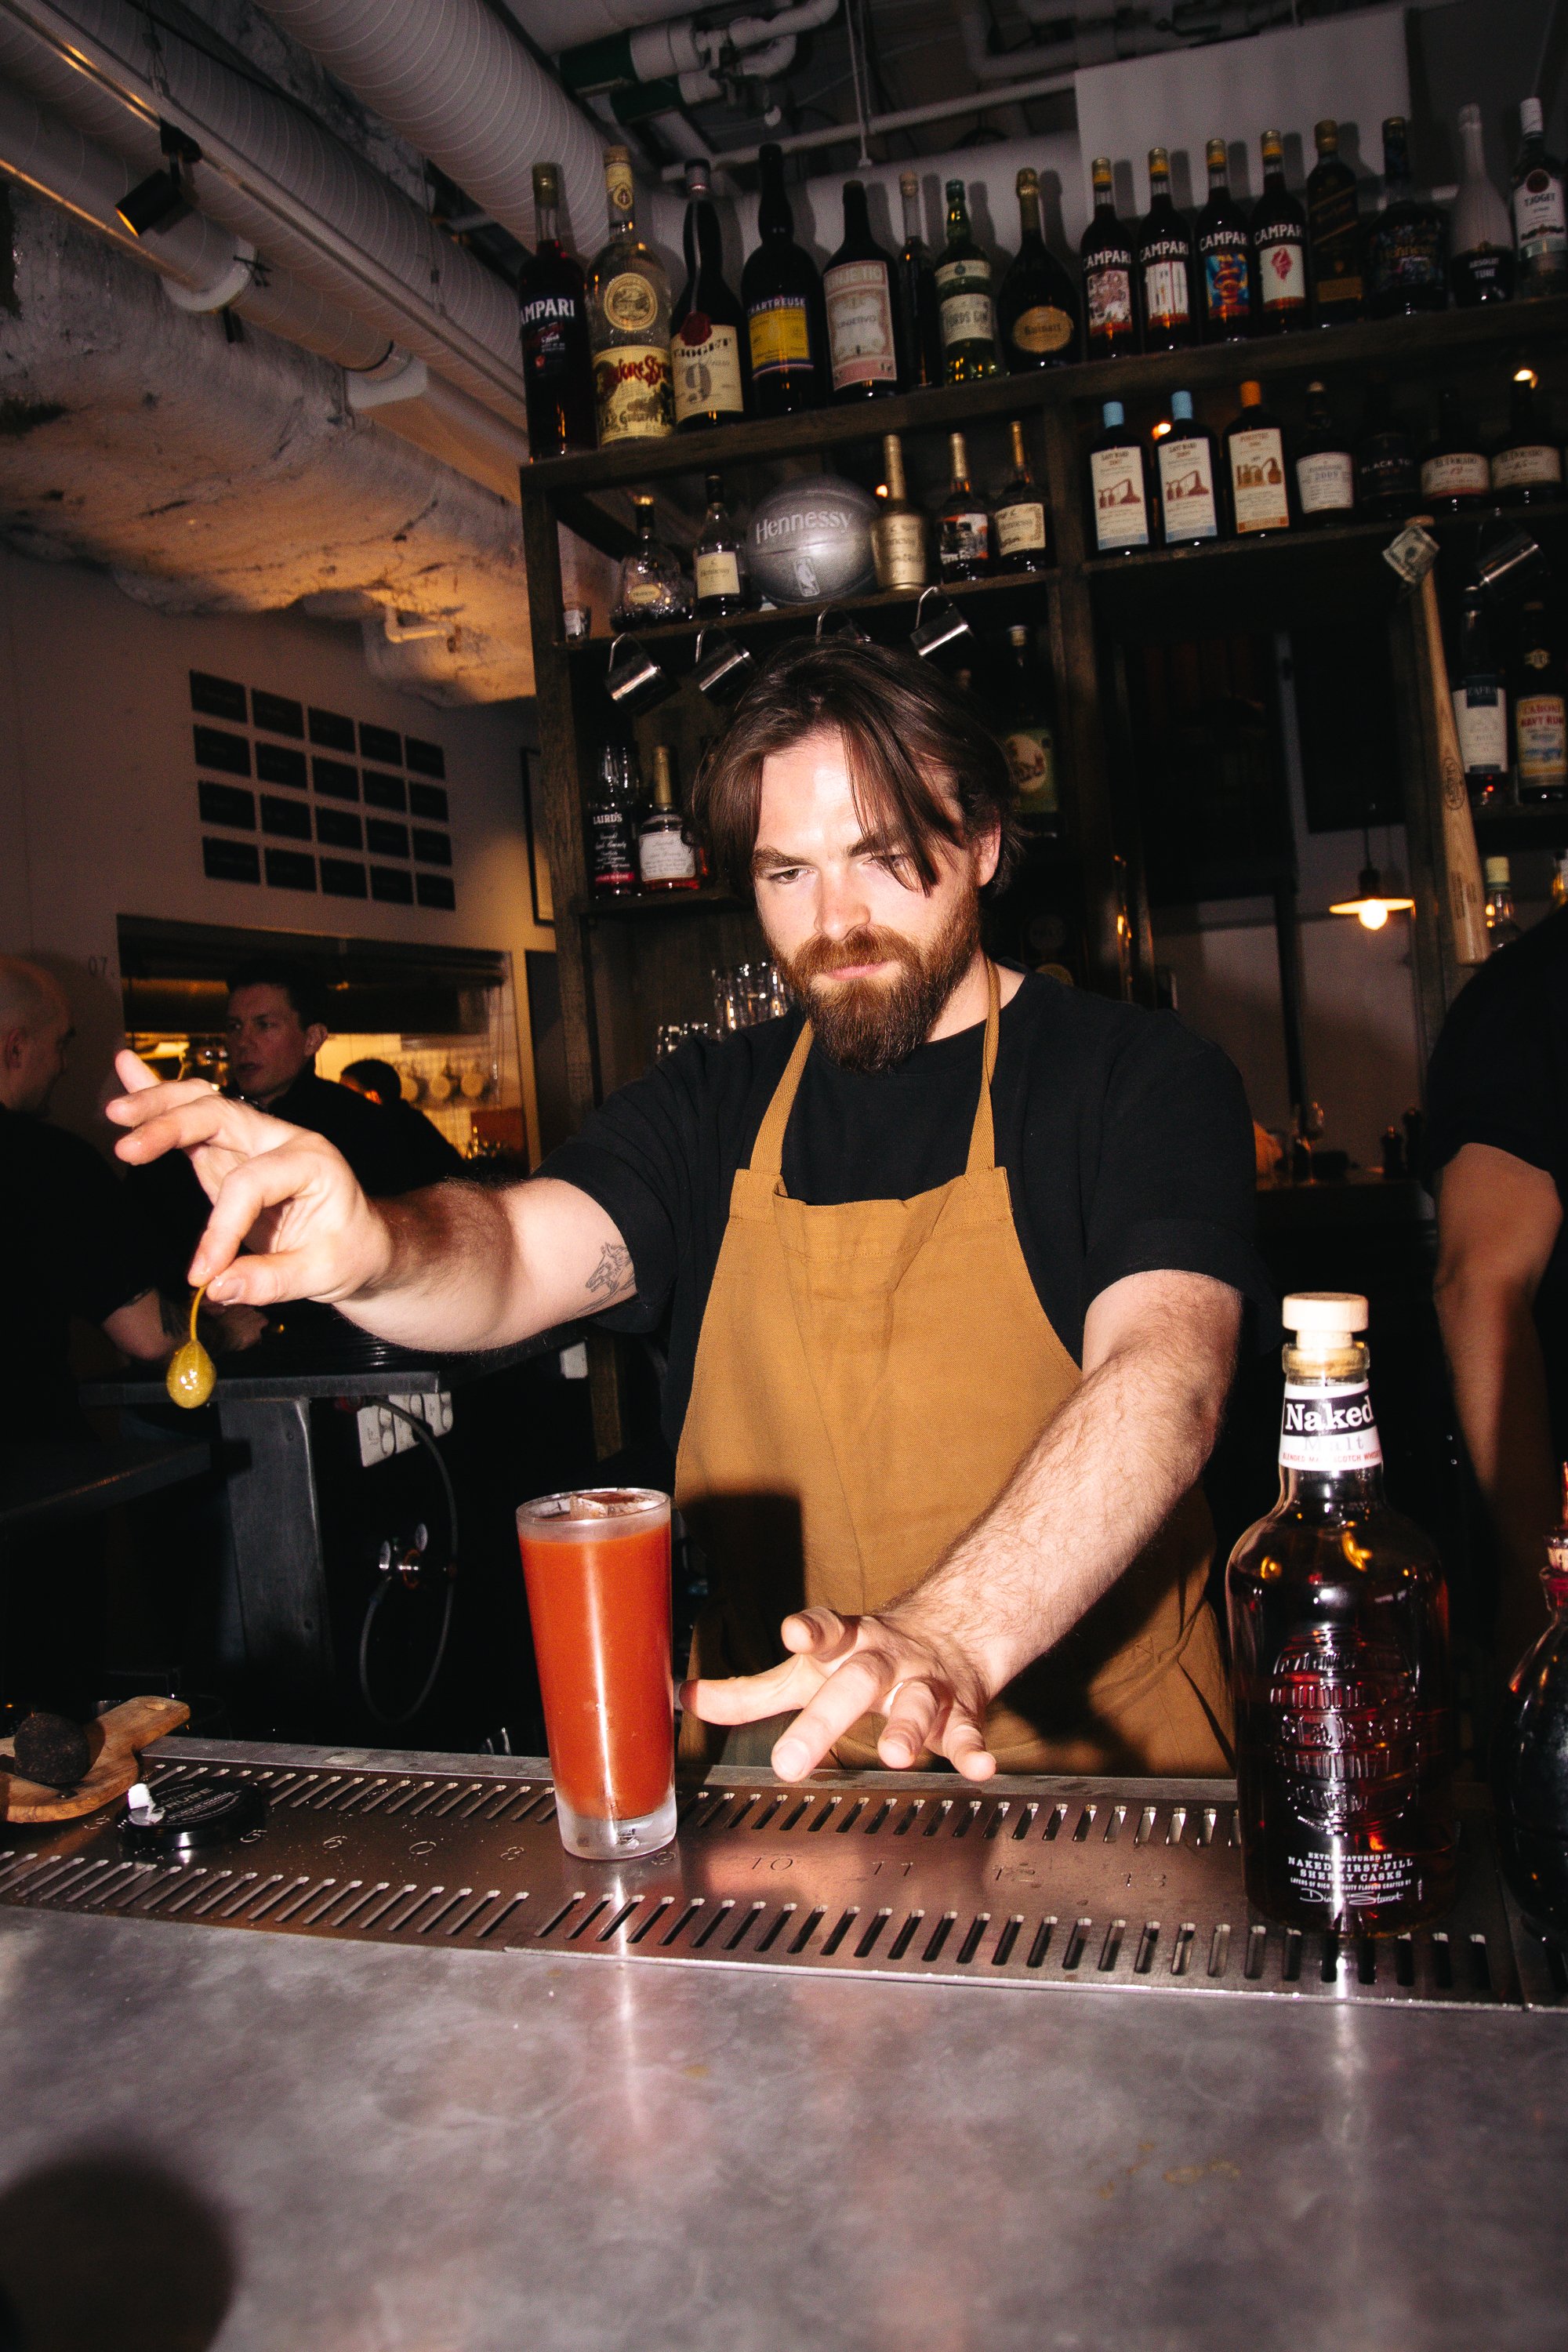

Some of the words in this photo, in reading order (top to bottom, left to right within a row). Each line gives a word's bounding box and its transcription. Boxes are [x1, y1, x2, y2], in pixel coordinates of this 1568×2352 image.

[1199, 230, 1247, 252] CAMPAR
[1254, 223, 1302, 245] CAMPAR
[520, 298, 575, 325] AMPARI
[755, 510, 853, 545] Hennessy
[1285, 1395, 1374, 1432] Naked
[1303, 1436, 1365, 1451] Malt
[239, 1828, 268, 1843] 5
[322, 1835, 348, 1849] 6
[499, 1846, 525, 1861] 8
[751, 1857, 793, 1871] 10
[1308, 1852, 1337, 1861] EXTR
[1340, 1853, 1381, 1863] MATURED
[1287, 1856, 1332, 1871] NAKED
[1338, 1858, 1414, 1873] FIRST-FILL
[1359, 1870, 1403, 1882] CASKS
